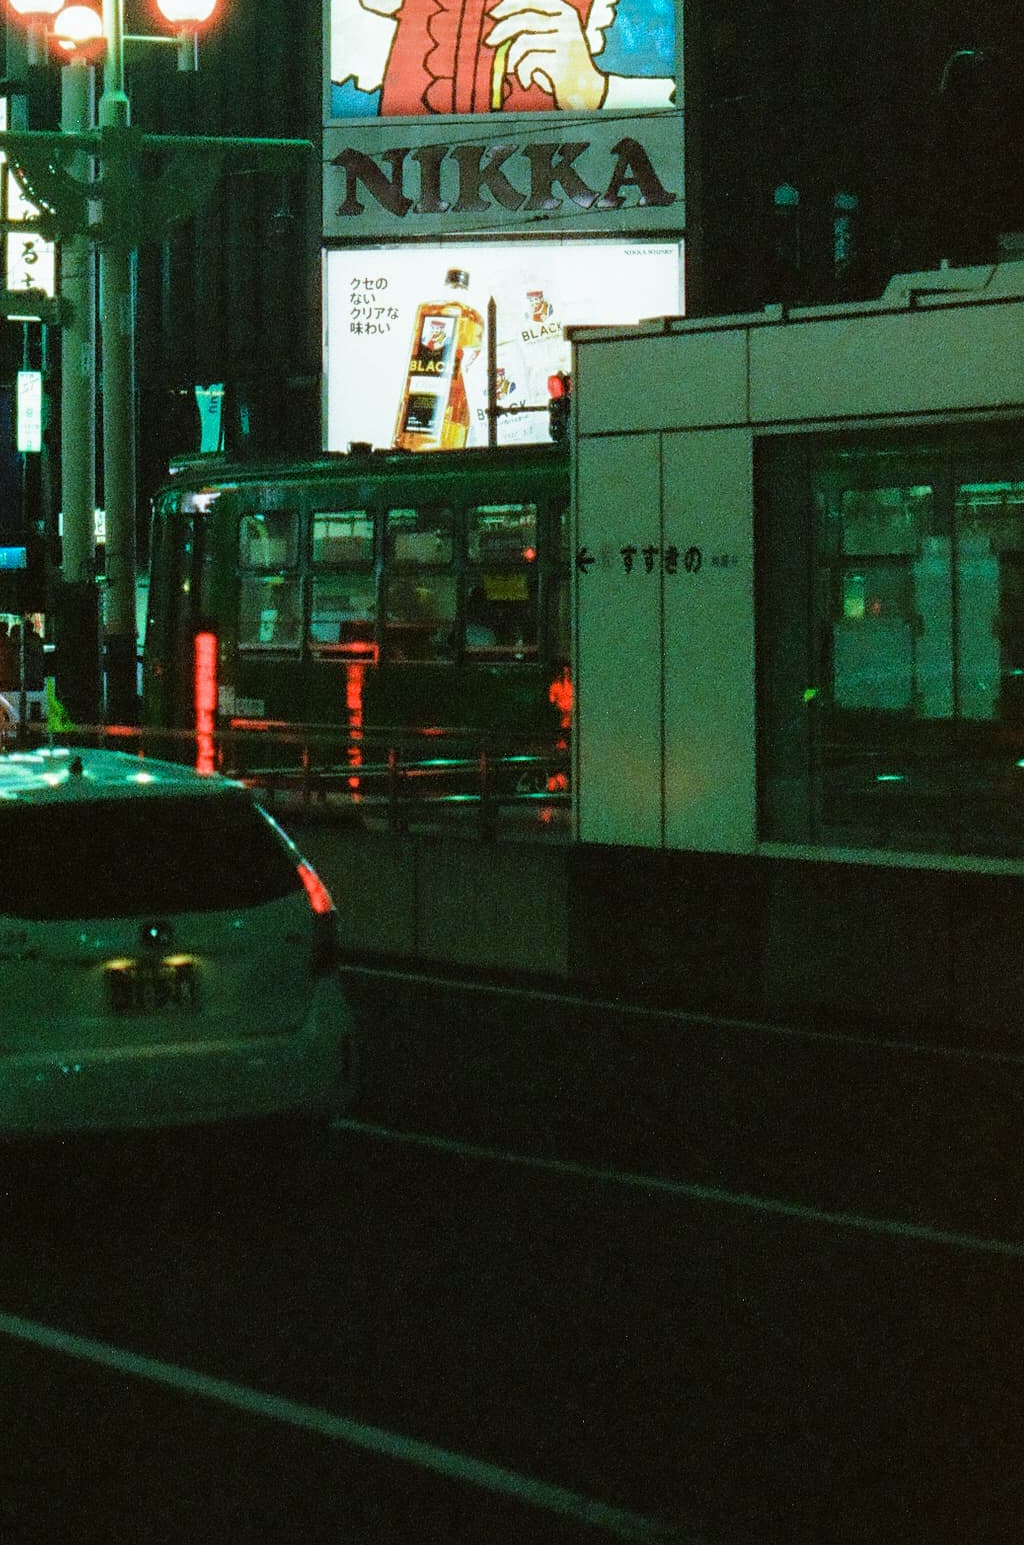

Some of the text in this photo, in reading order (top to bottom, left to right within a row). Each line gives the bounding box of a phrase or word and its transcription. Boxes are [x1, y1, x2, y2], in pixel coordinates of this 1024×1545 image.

[330, 137, 676, 217] NIKKA
[349, 277, 388, 290] クセの
[350, 292, 376, 304] ない
[350, 306, 400, 320] クリアな
[350, 322, 391, 335] 味わい
[521, 322, 562, 342] BLACK
[410, 360, 446, 373] BLAC
[620, 545, 702, 574] すすきの
